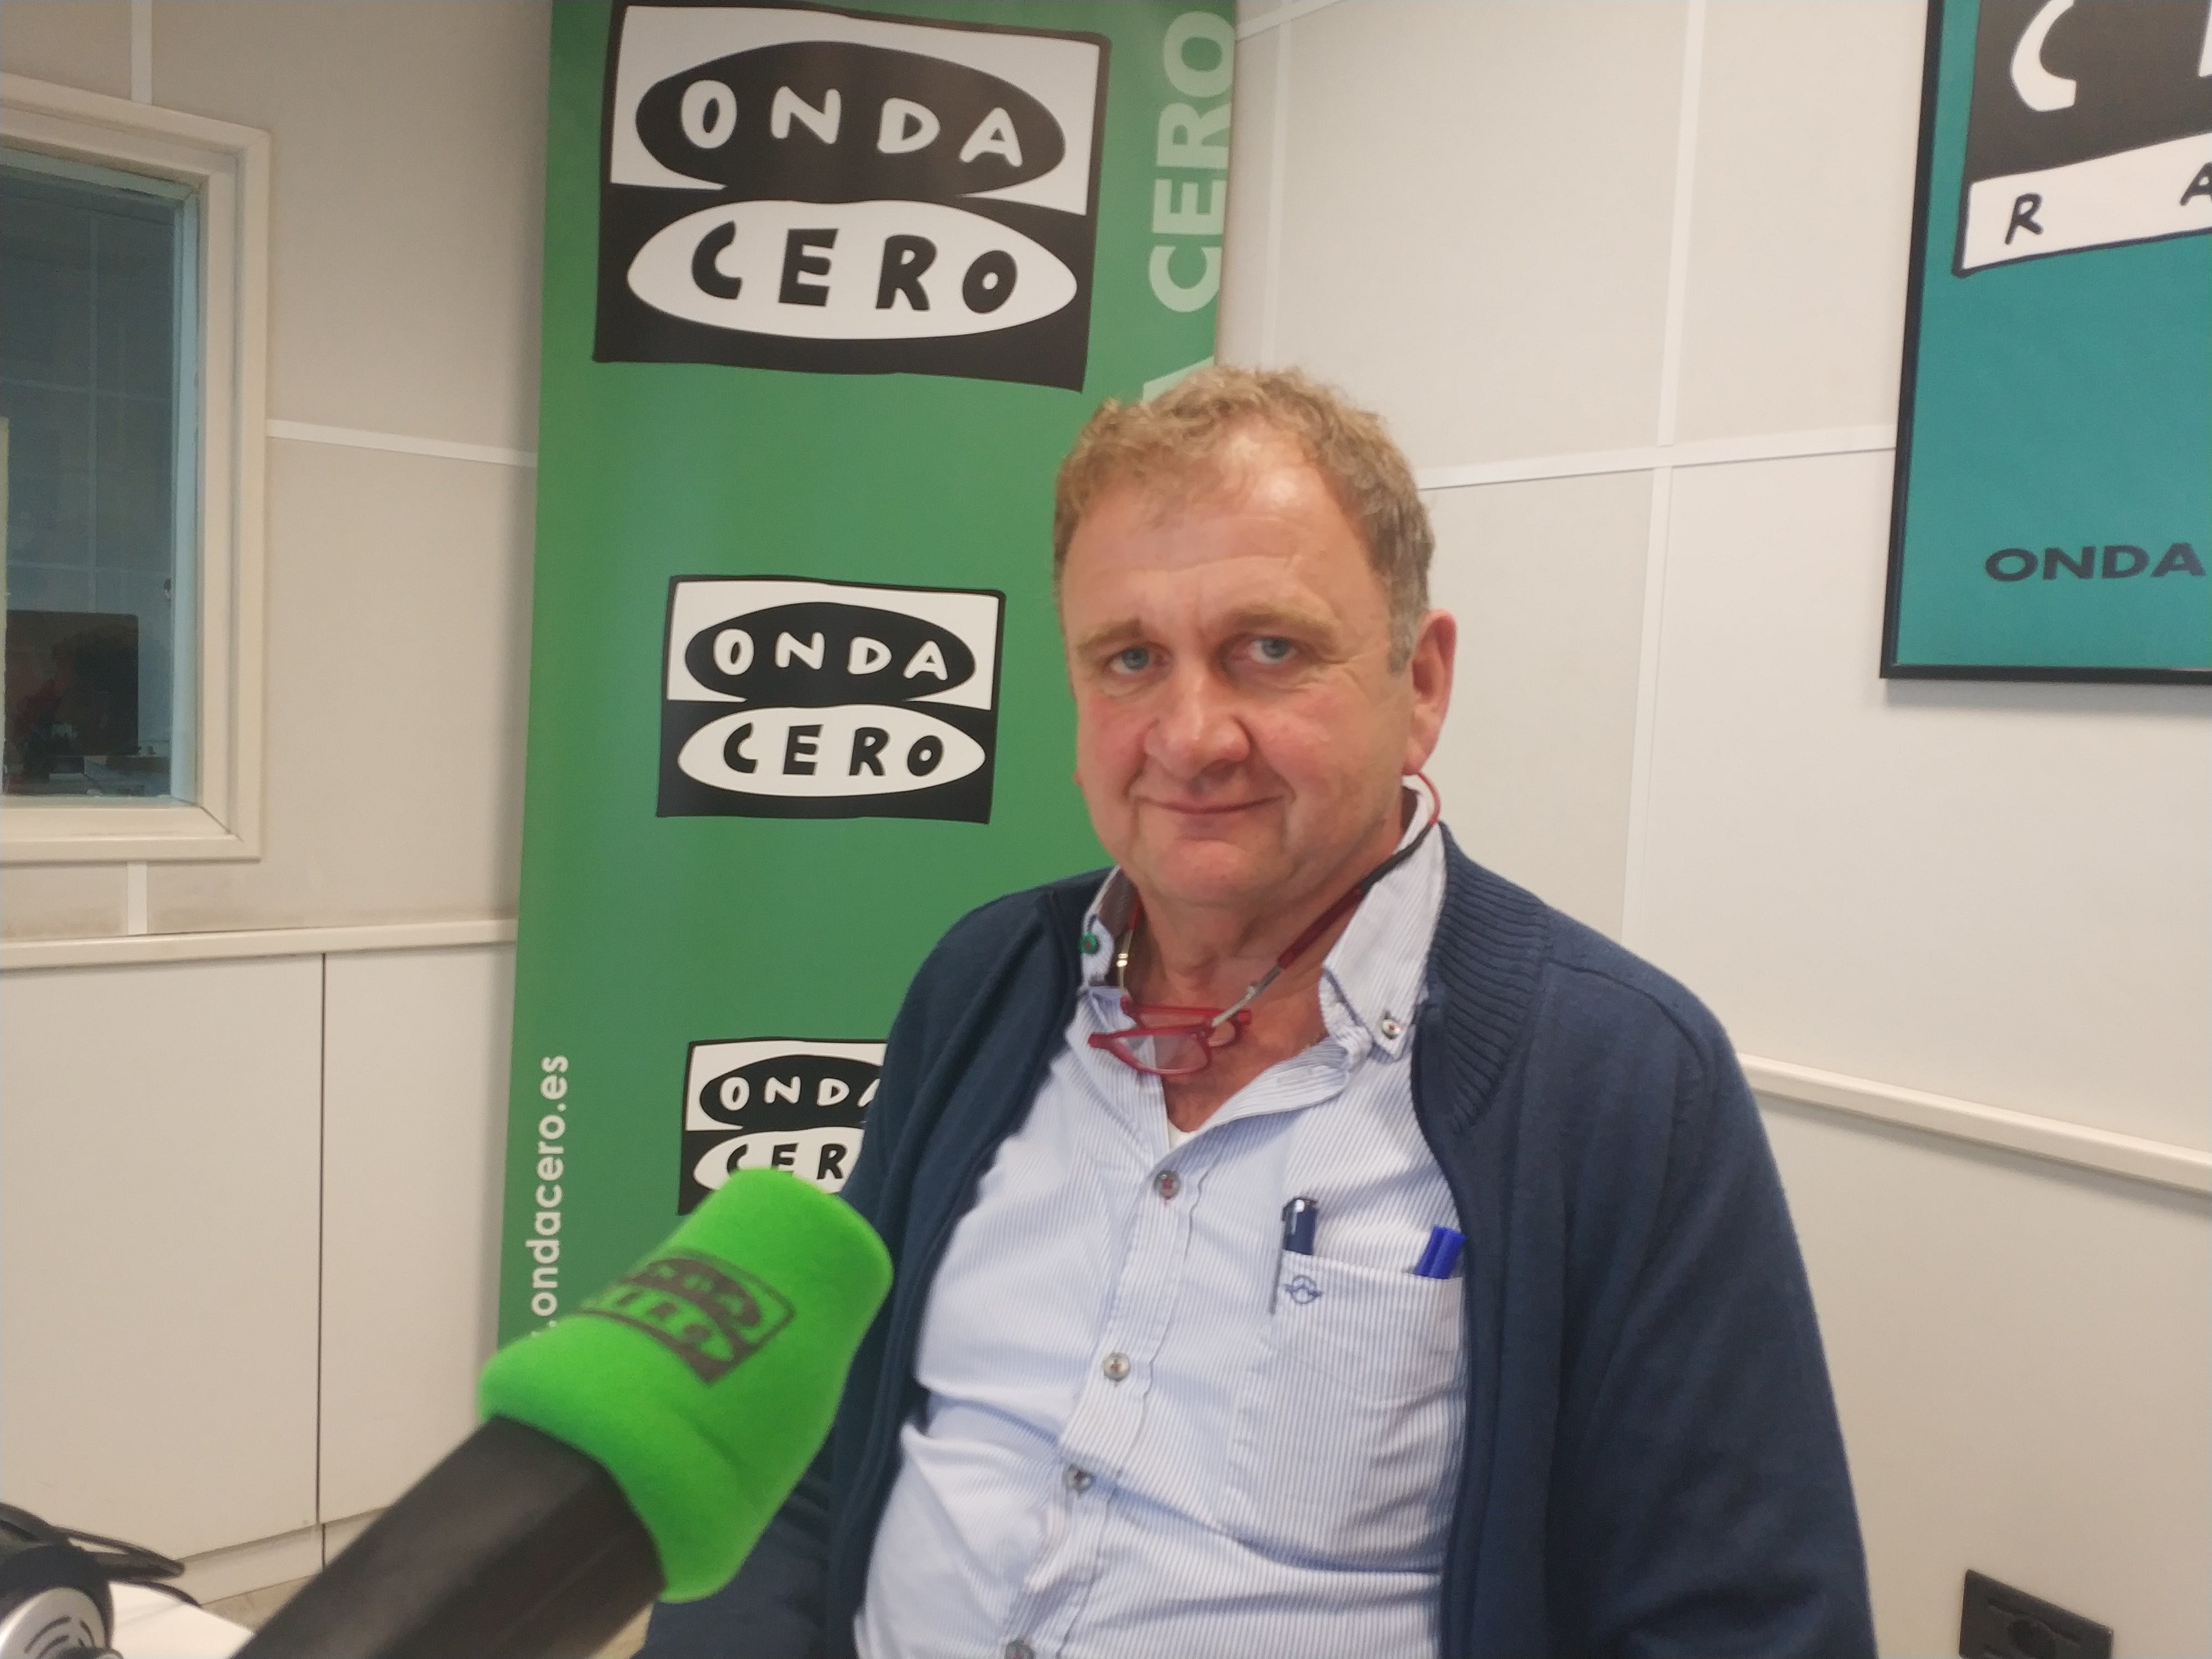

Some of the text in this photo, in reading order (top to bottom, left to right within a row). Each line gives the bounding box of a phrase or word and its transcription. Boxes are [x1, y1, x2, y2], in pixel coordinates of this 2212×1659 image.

[681, 79, 1022, 168] ONDA
[1149, 11, 1234, 312] CERO
[691, 221, 1018, 315] CERO
[1985, 542, 2206, 582] ONDA
[713, 628, 948, 681] ONDA
[723, 722, 945, 778] CERO
[525, 1055, 569, 1337] .ondacero.es
